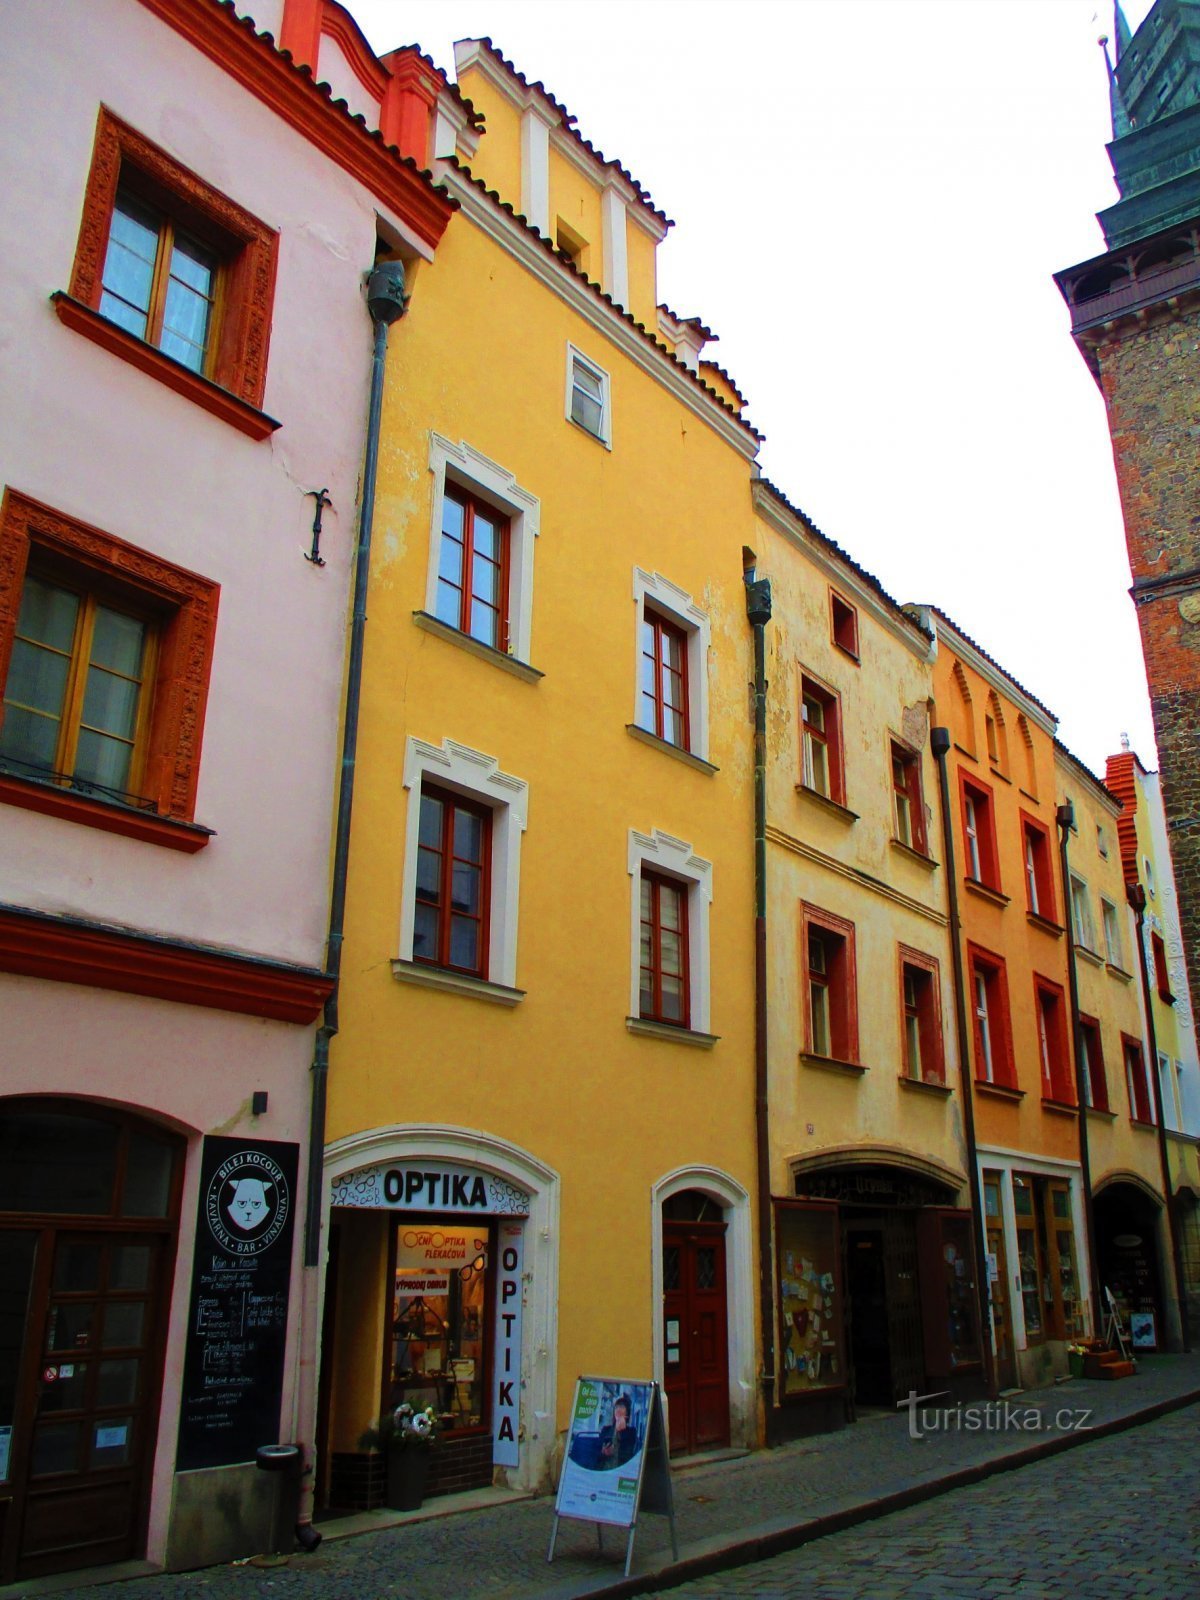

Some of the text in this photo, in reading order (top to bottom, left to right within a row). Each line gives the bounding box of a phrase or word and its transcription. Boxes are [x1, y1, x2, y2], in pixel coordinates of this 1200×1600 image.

[218, 1153, 282, 1183] BÍLEJ KOCOUR
[383, 1169, 488, 1207] OPTIKA
[209, 1194, 229, 1246] KAVÁRNA
[262, 1197, 287, 1245] VINÁRNA
[237, 1242, 256, 1253] BAR
[425, 1249, 466, 1259] FLEKAČOVÁ
[396, 1279, 427, 1291] VÝPRODEJ
[498, 1247, 518, 1442] OPTIKA
